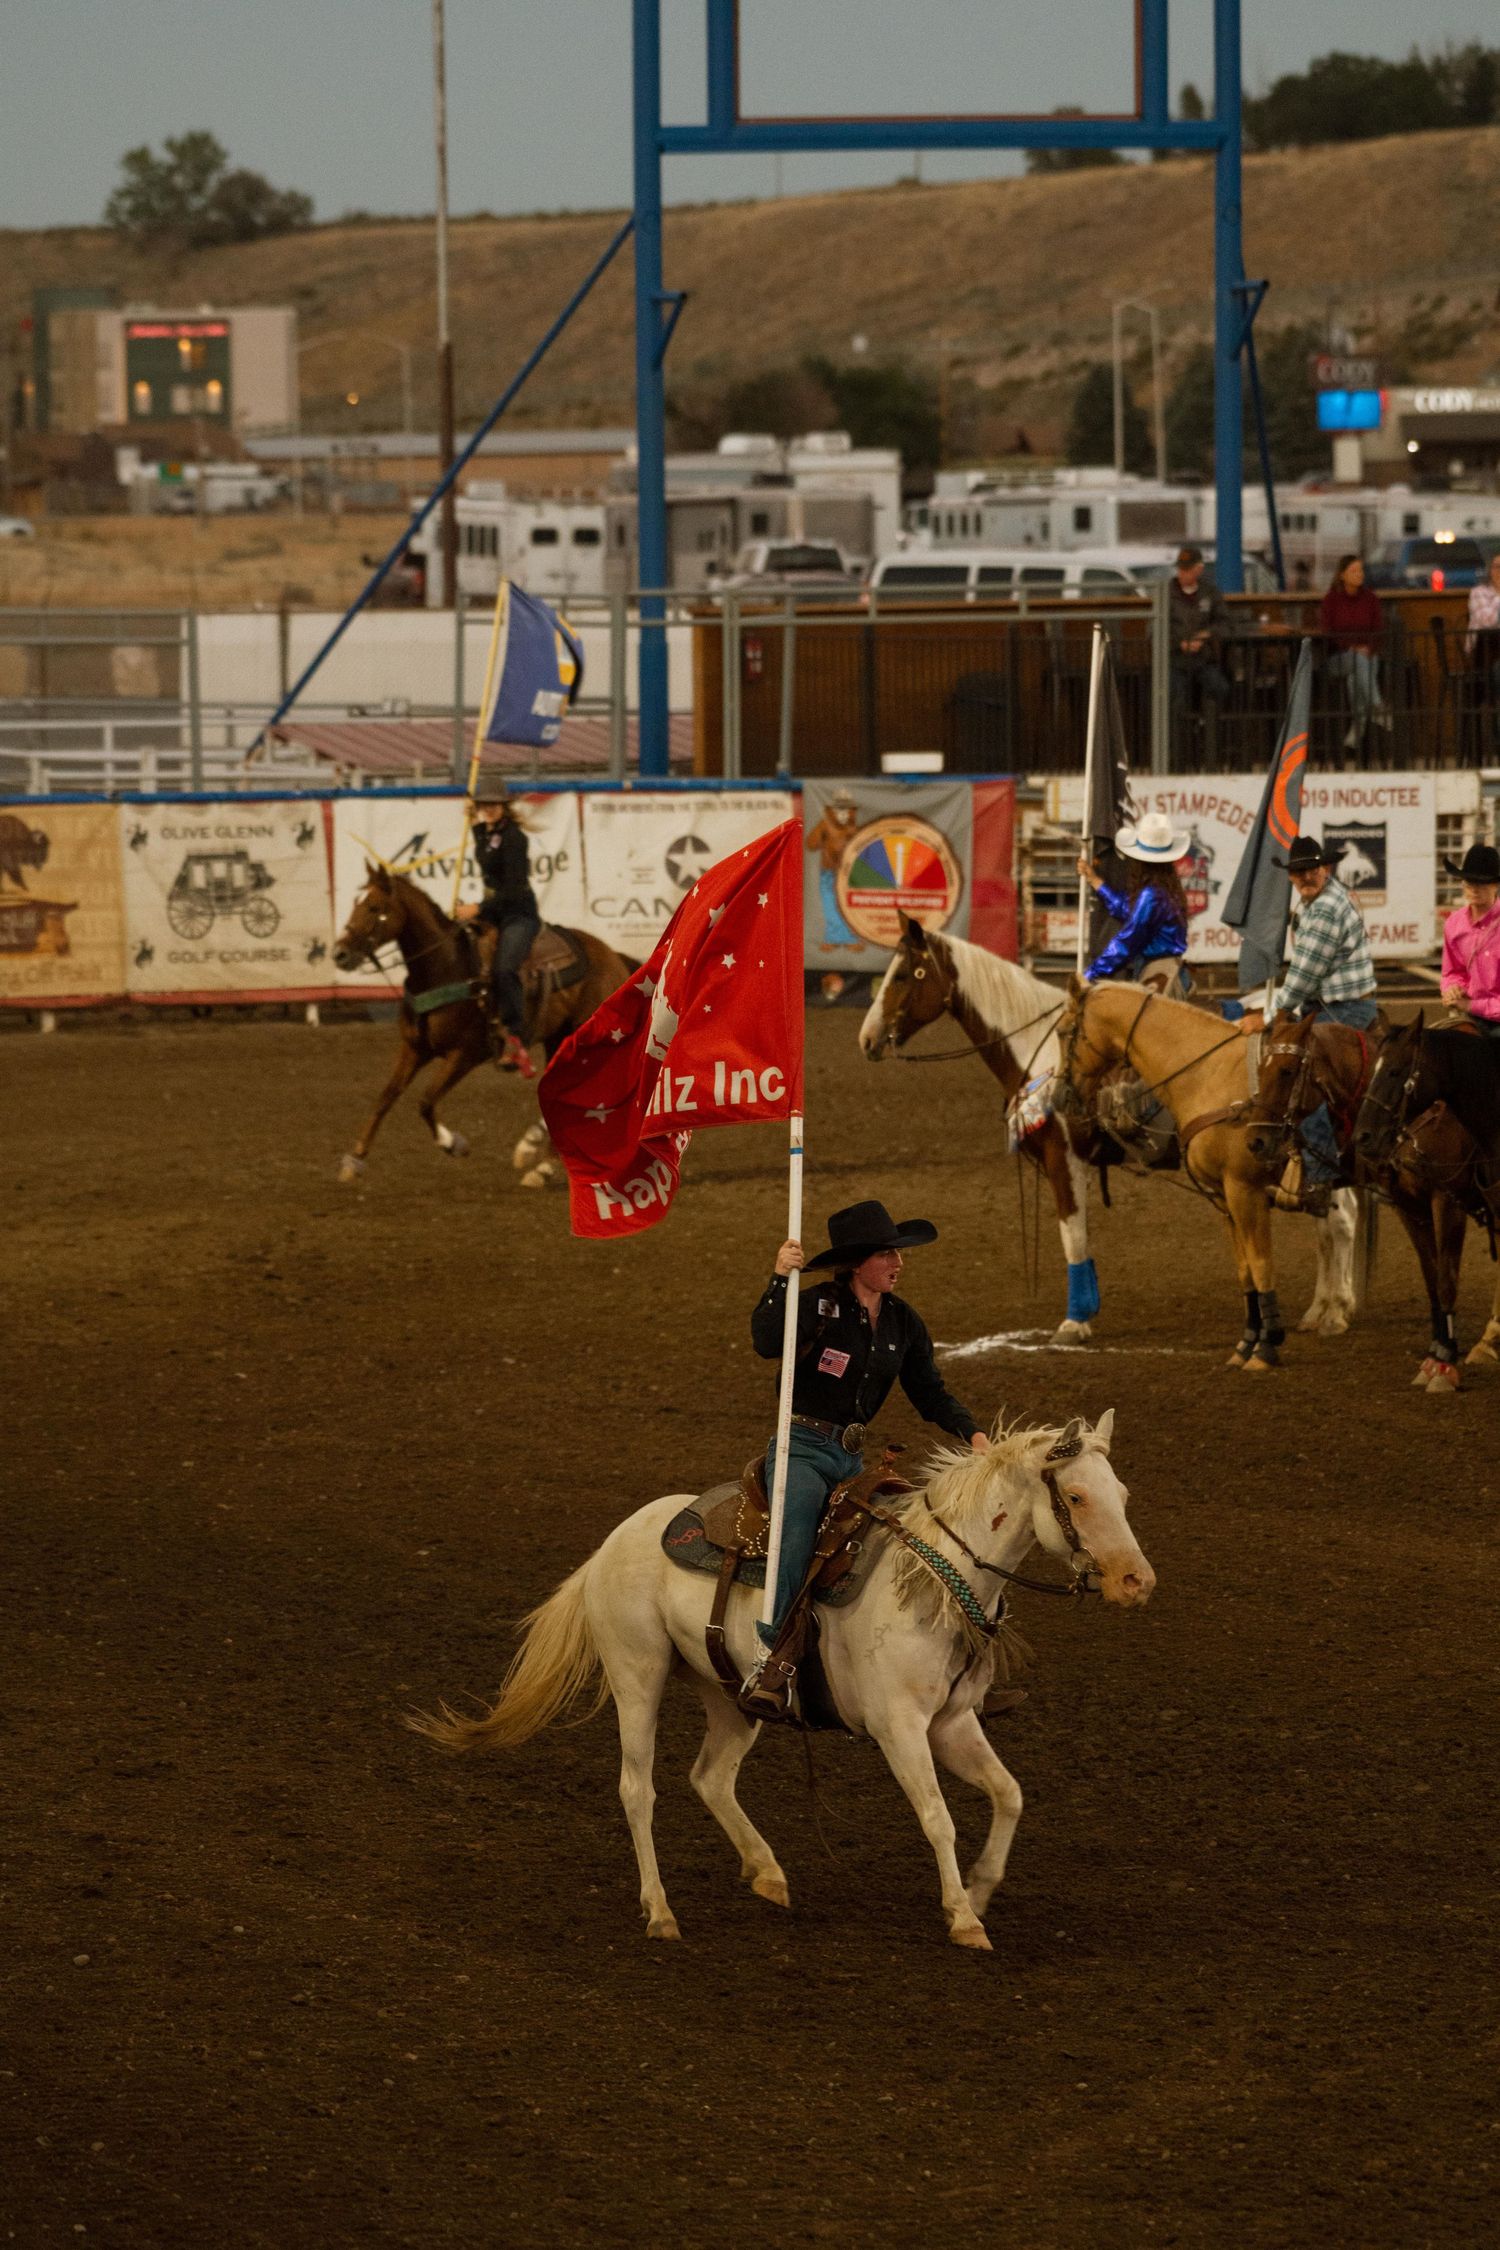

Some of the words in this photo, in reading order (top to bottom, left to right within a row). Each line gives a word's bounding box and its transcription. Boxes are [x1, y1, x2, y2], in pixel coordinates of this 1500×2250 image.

[1300, 789, 1328, 808] 019
[1333, 788, 1420, 808] INDUCTEE
[1156, 792, 1256, 835] STAMPEDE
[160, 826, 209, 840] OLIVE
[214, 825, 274, 839] GLENN
[1205, 928, 1241, 947] ROD
[1369, 924, 1419, 944] FAME
[167, 950, 212, 964] GOLF
[218, 949, 290, 963] COURSE
[645, 1066, 698, 1117] ilz
[714, 1060, 786, 1107] Inc
[591, 1159, 674, 1221] Hap
